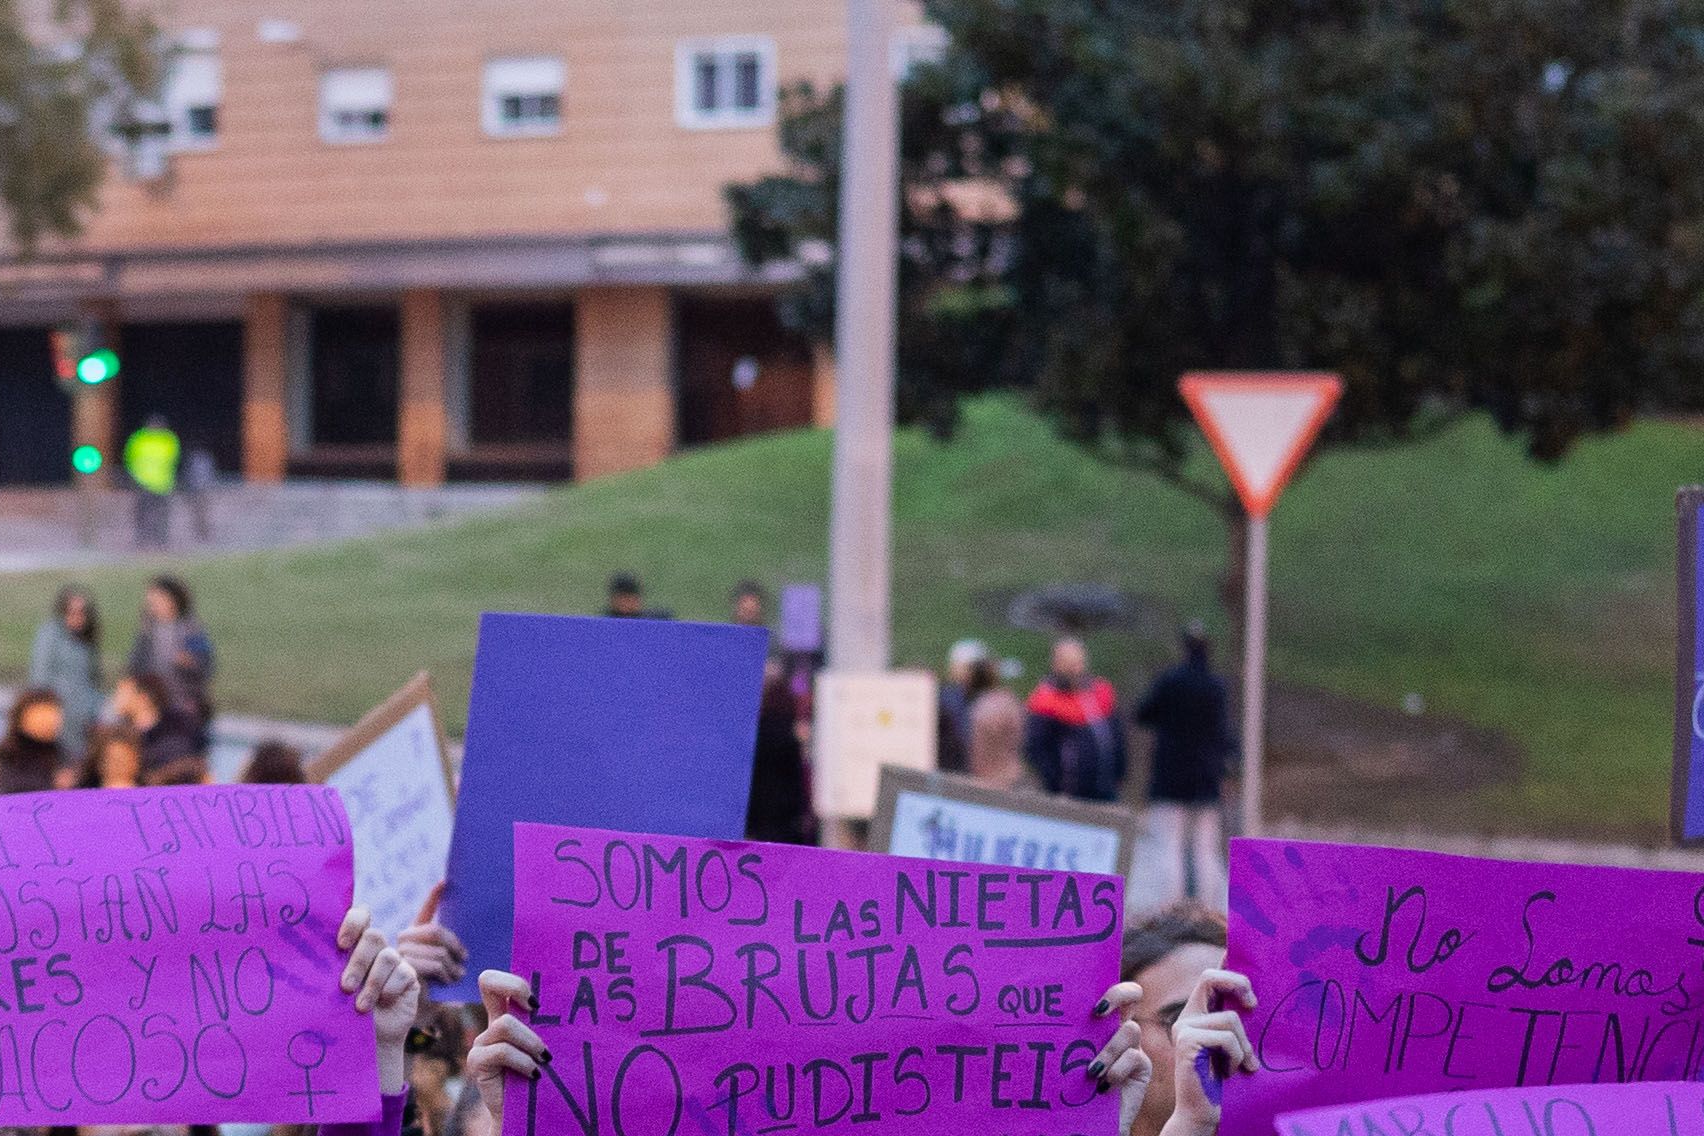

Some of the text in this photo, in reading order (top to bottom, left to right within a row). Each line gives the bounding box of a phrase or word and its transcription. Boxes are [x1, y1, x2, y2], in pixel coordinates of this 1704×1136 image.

[200, 860, 310, 935] LAS
[550, 839, 1118, 944] SOMOS LAS NIETAS
[129, 955, 160, 1010] Y
[190, 946, 276, 1022] NO
[530, 934, 1064, 1037] LAS BRUJAS QUE
[572, 931, 630, 971] DE
